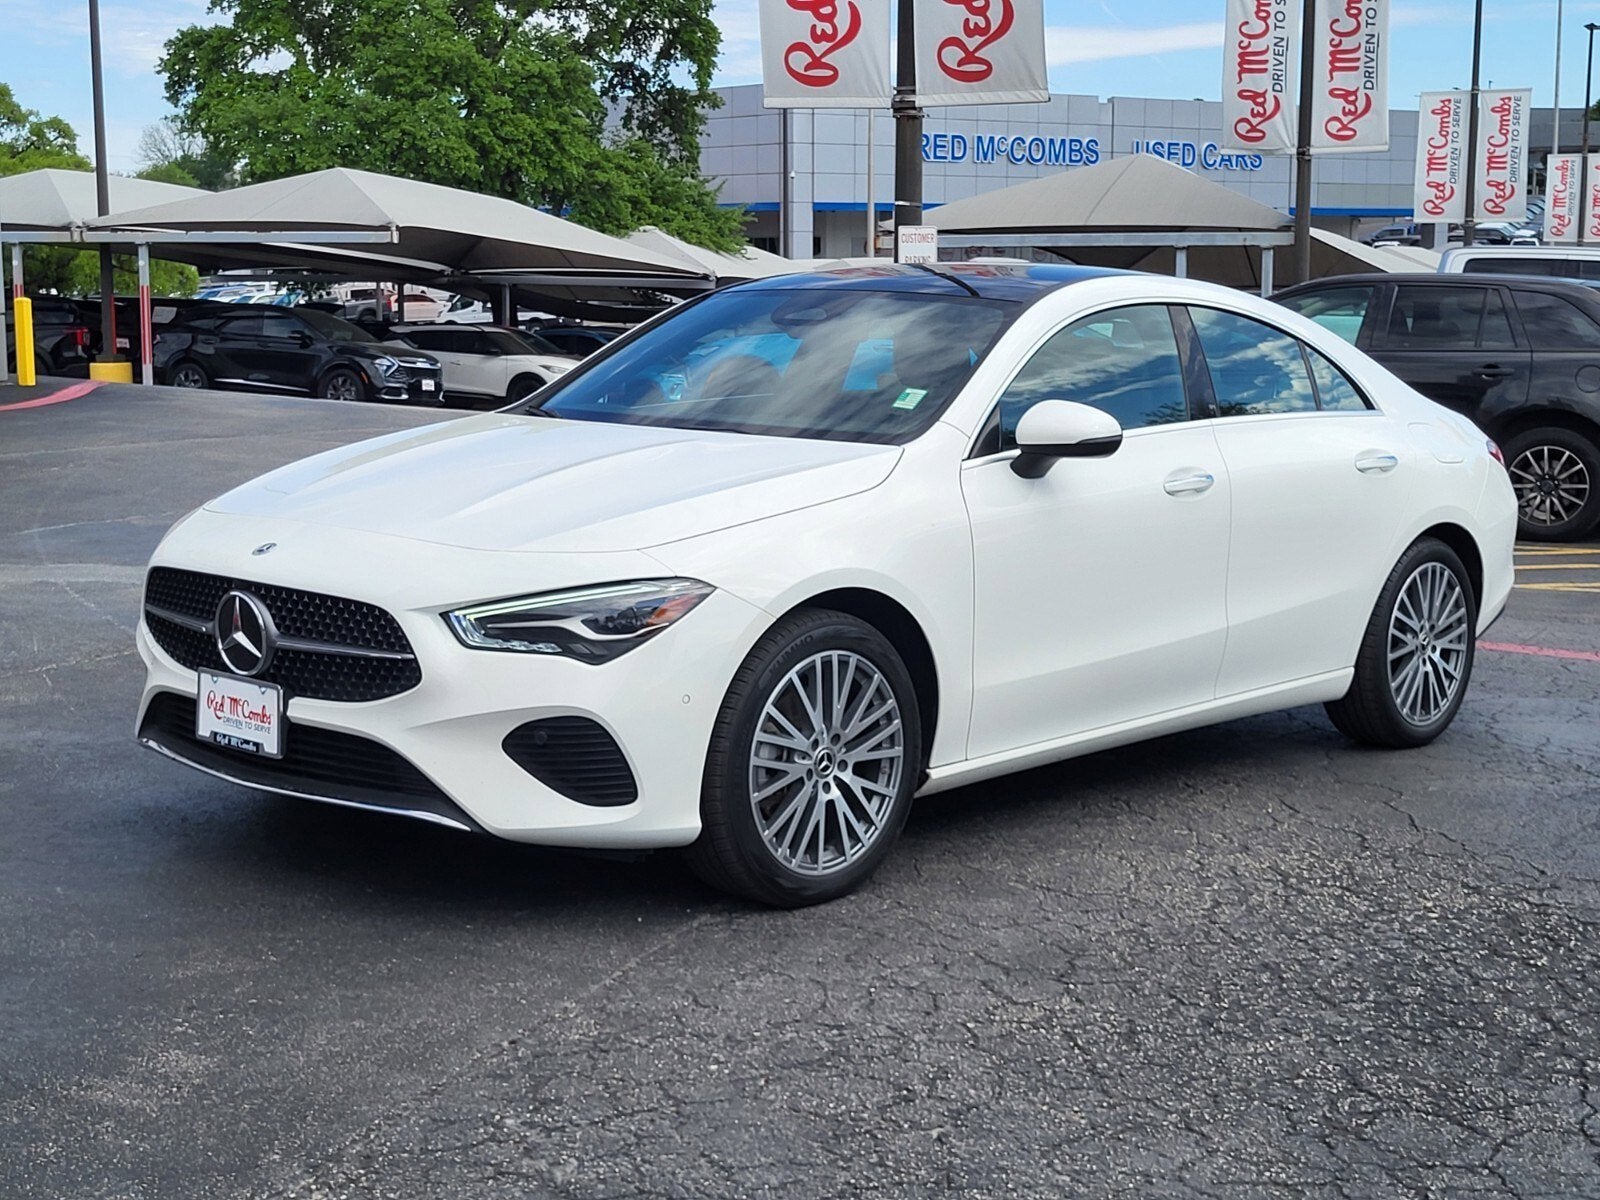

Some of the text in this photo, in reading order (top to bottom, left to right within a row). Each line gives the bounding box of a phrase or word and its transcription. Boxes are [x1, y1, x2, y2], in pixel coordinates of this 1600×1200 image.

[1273, 10, 1286, 31] TO
[1364, 7, 1377, 90] DRIVEN TO
[1272, 36, 1286, 93] DRIVEN
[1324, 0, 1372, 142] Red McCo
[922, 134, 968, 161] RED
[1234, 88, 1280, 143] Red
[1449, 97, 1462, 184] DRIVEN TO SERVE
[1509, 95, 1522, 183] DRIVEN TO SERVE
[1423, 98, 1455, 215] Red McCombs
[1483, 96, 1516, 215] Red McCombs
[1550, 159, 1571, 236] Red McCombs
[901, 233, 935, 244] CUSTOMER
[207, 690, 272, 726] Red McCombs
[223, 716, 272, 735] DRIVEN TO SERVE
